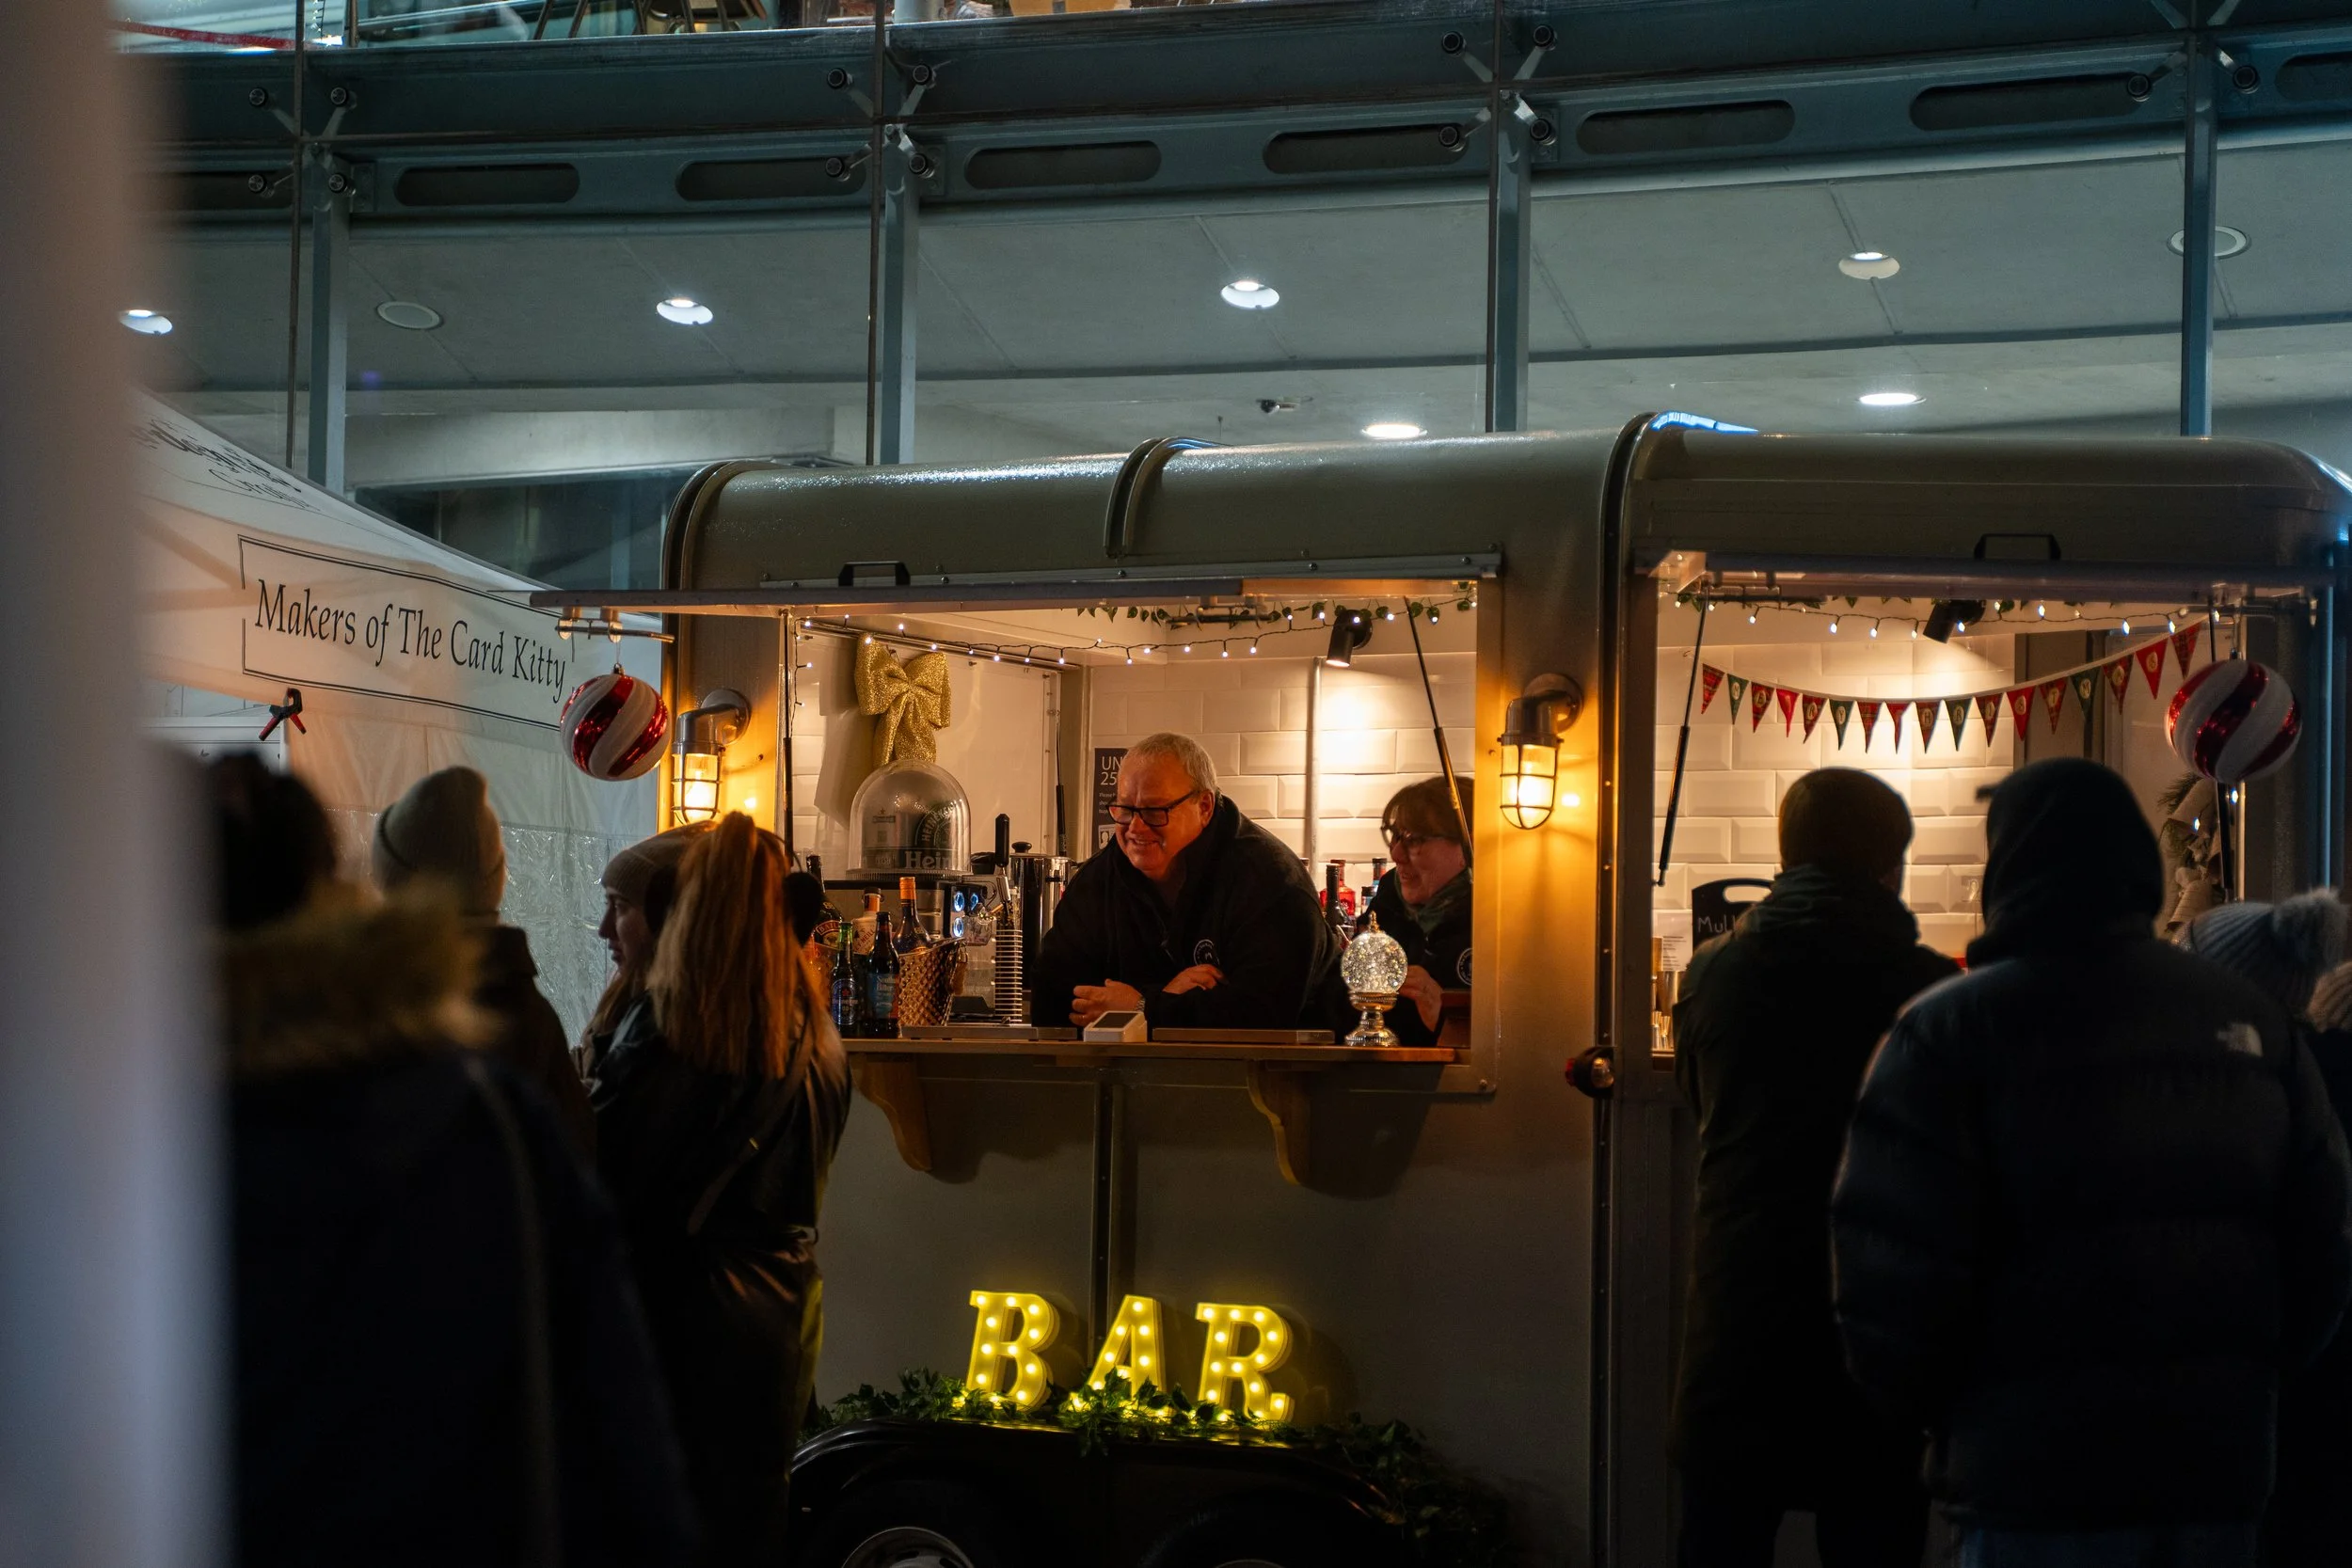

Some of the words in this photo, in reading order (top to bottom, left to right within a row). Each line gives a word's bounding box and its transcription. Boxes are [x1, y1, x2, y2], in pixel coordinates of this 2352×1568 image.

[255, 578, 356, 645] Makers
[366, 603, 393, 667] of
[398, 607, 442, 659] The
[450, 620, 505, 675] Card
[512, 635, 566, 705] Kitty
[818, 922, 839, 932] BAIL
[1697, 914, 1736, 933] Mull
[954, 1291, 1295, 1422] BAR
